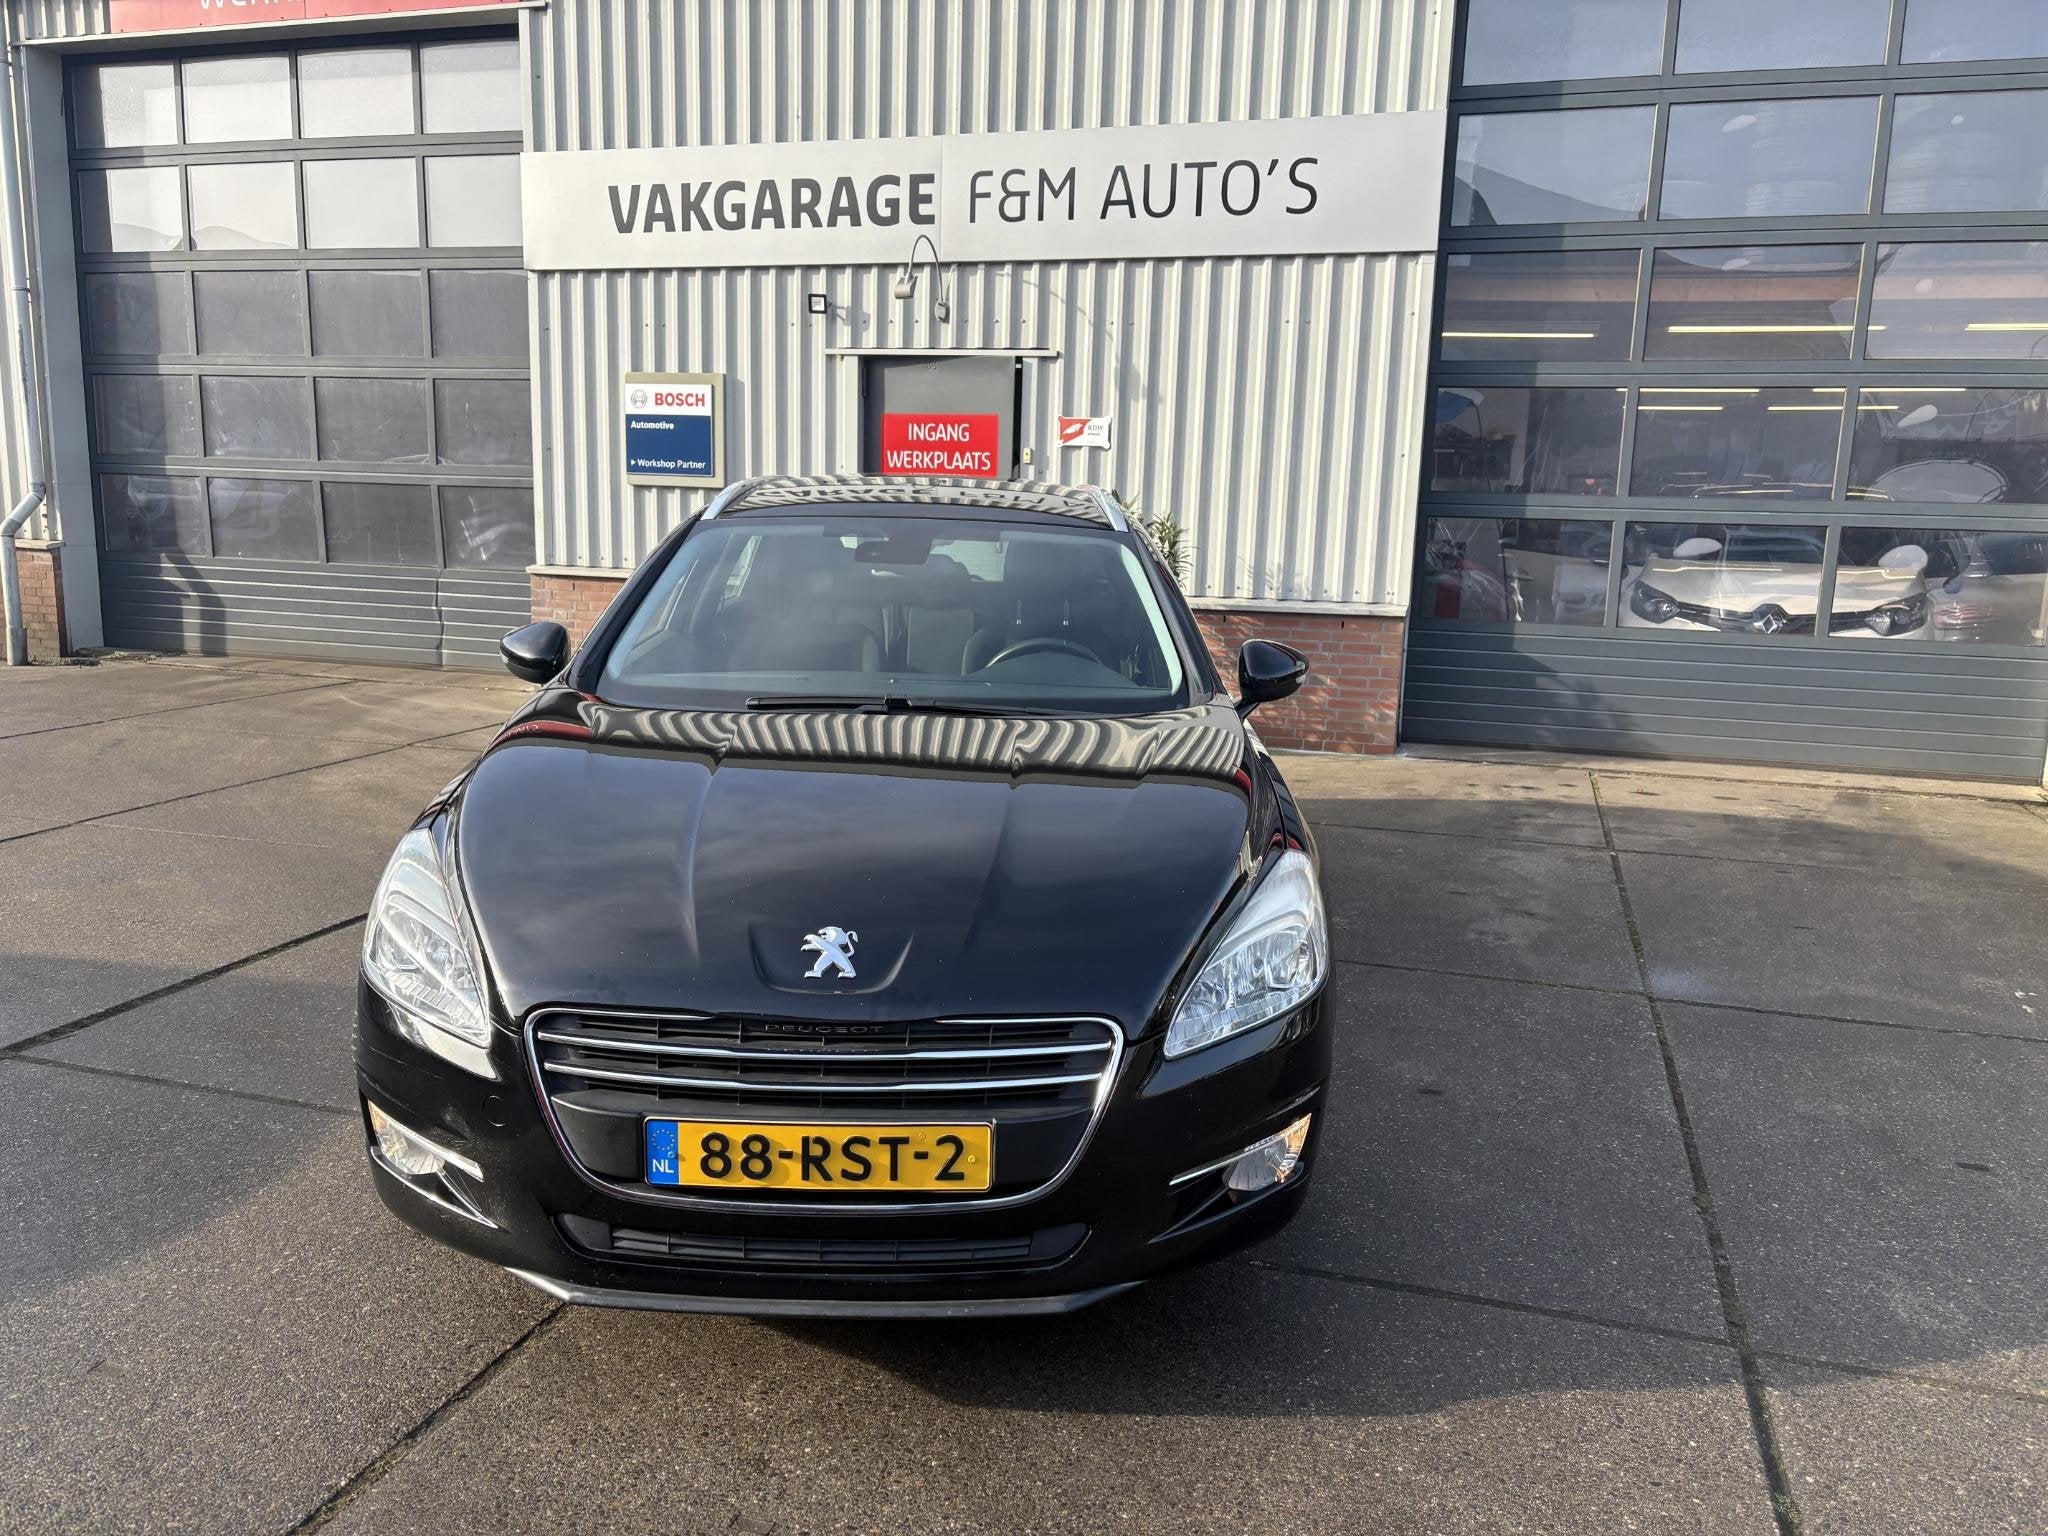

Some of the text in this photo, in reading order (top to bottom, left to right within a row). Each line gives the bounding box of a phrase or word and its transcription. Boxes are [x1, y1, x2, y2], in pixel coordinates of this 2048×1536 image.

[608, 157, 1319, 234] VAKGARAGE F&M AUTO'S
[654, 392, 705, 407] BOSCH
[630, 420, 675, 430] Automotive
[908, 423, 970, 441] INGANG
[637, 459, 706, 469] Workshop Partner
[887, 450, 991, 470] WERKPLAATS
[765, 1024, 883, 1033] PEUGEOT
[700, 1131, 965, 1182] 88-RST-2
[652, 1158, 674, 1173] NL
